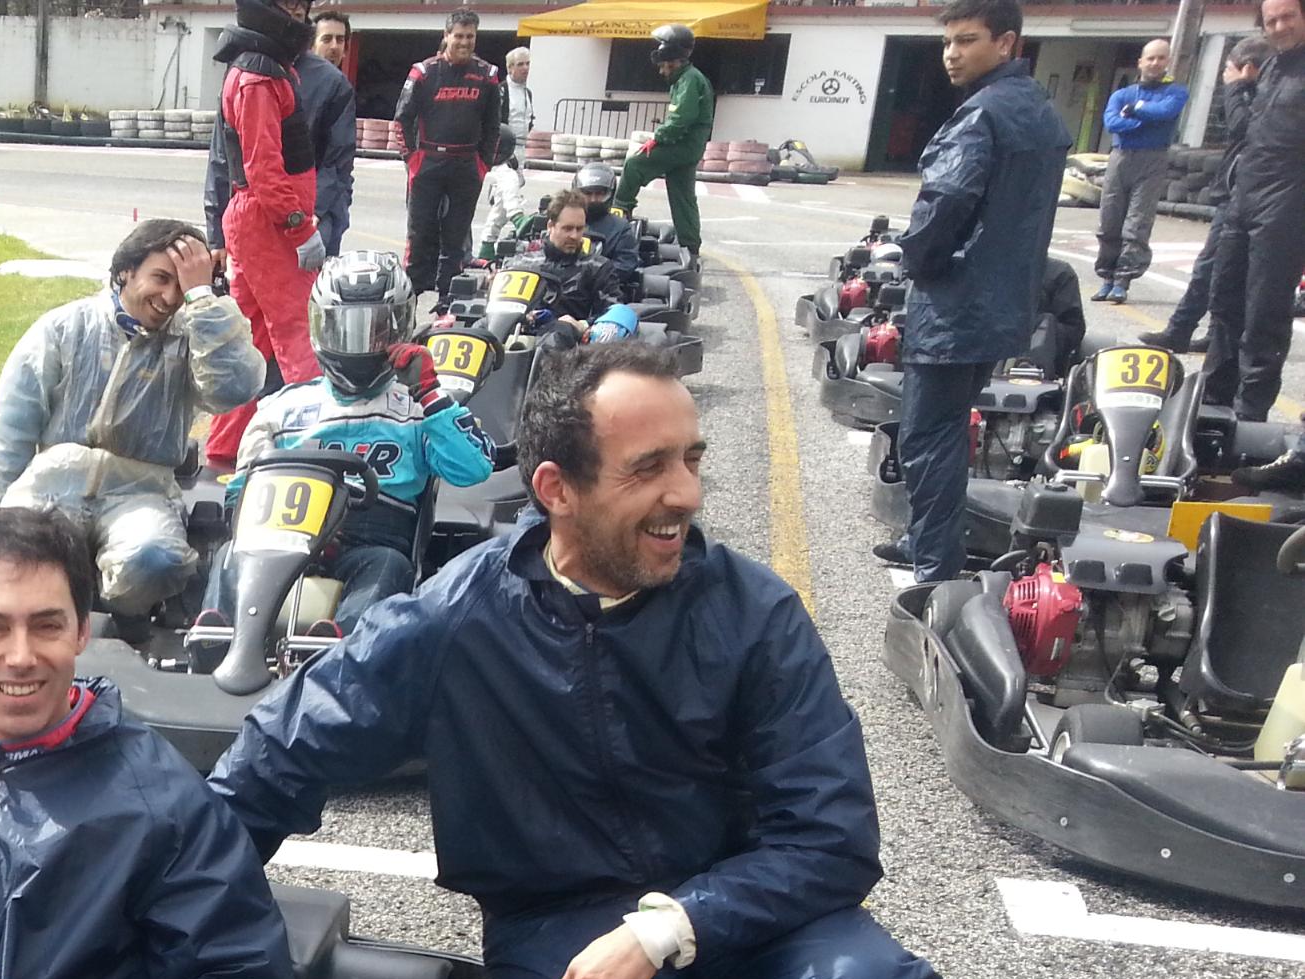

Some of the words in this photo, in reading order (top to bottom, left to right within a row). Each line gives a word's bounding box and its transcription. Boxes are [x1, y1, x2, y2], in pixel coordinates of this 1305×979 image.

[791, 70, 827, 101] ESCOLA
[833, 70, 867, 104] KARTING
[497, 274, 530, 296] 21
[434, 338, 474, 369] 93
[1121, 353, 1164, 387] 32
[255, 482, 311, 525] 99
